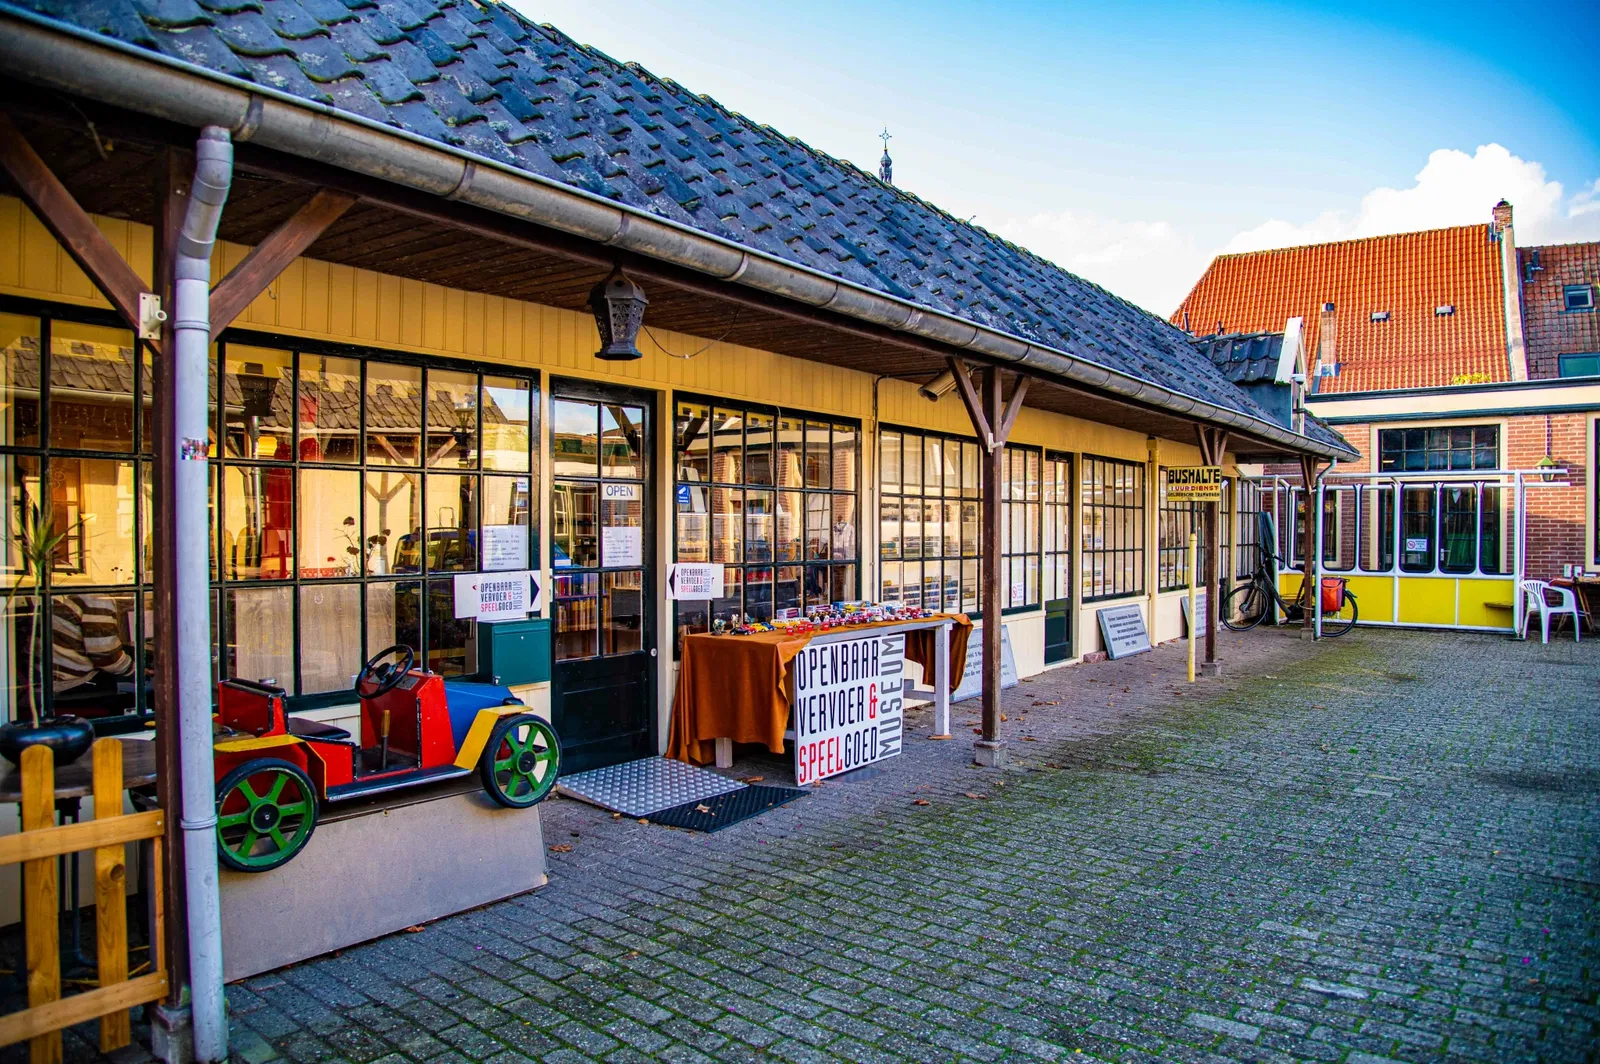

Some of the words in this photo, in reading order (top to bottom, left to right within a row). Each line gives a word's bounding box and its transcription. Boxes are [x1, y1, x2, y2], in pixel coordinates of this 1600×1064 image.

[1168, 469, 1220, 483] BUSHALTE
[606, 485, 633, 496] OPEN
[480, 581, 513, 593] OPENBAAR
[480, 591, 507, 603] VERVOER
[507, 591, 512, 601] &
[512, 580, 523, 610] MUSEUM
[480, 601, 513, 613] SPEELGOED
[798, 639, 879, 691] OPENBAAR
[879, 635, 904, 759] MUSEUM
[798, 685, 865, 738] VERVOER
[869, 683, 878, 720] &
[799, 726, 878, 784] SPEELGOED
